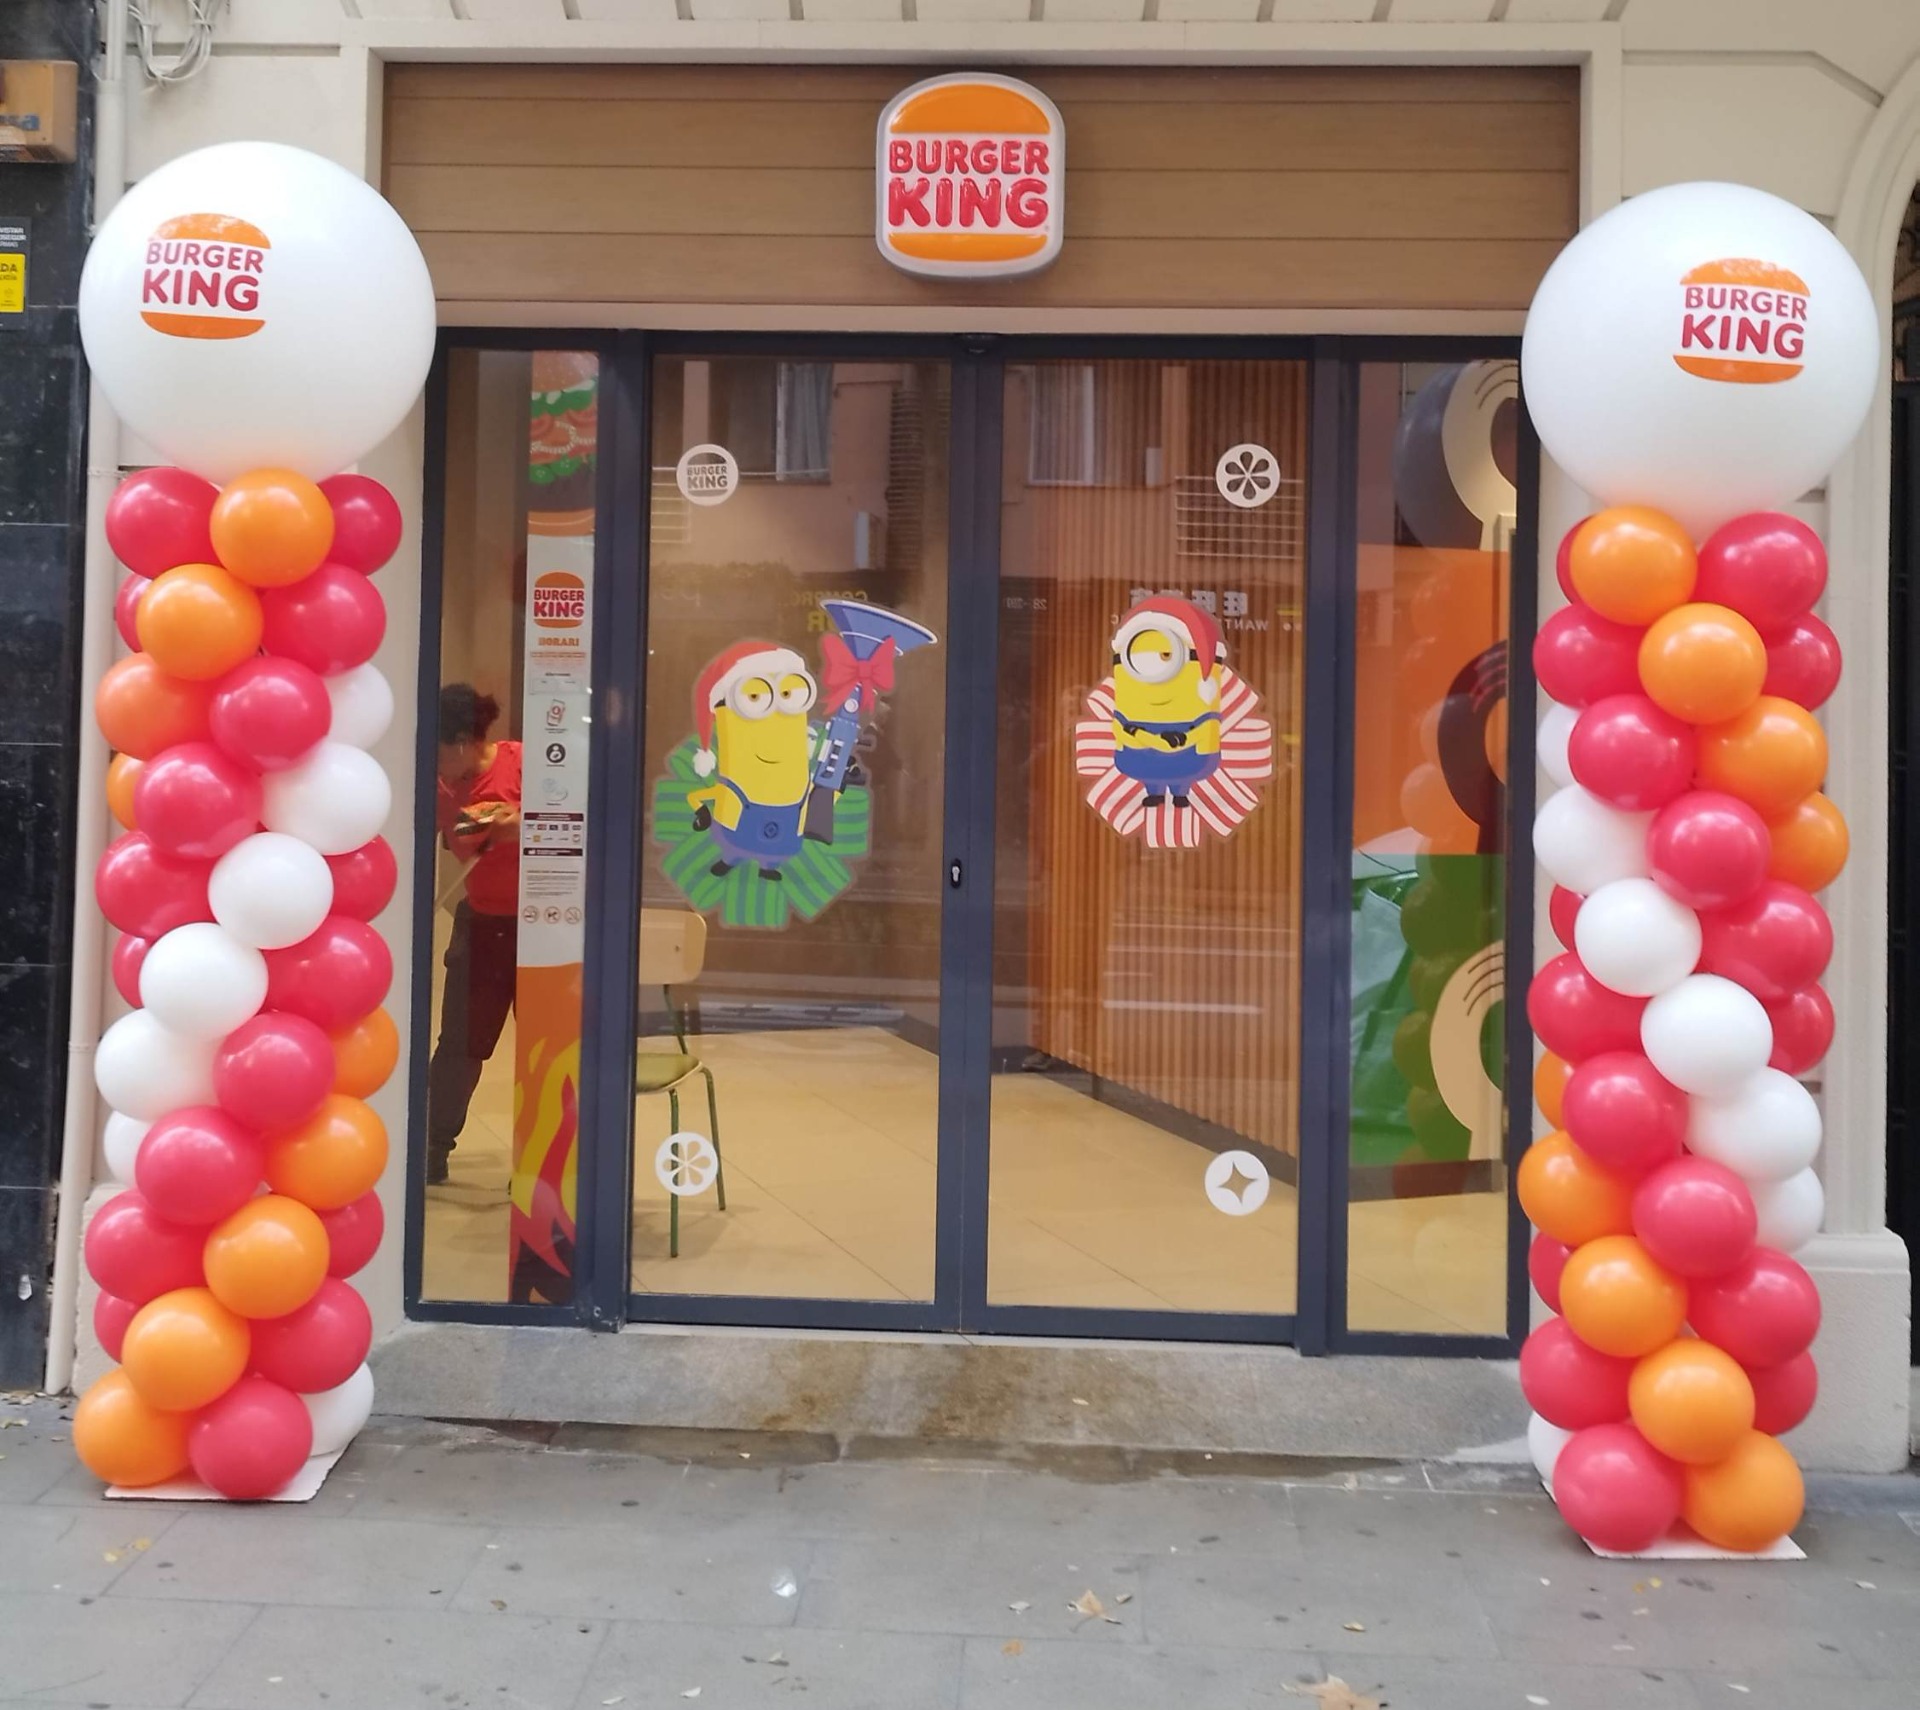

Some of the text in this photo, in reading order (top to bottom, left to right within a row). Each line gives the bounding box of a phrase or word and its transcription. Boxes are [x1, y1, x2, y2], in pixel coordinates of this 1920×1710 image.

[889, 140, 1050, 175] BURGER
[888, 177, 1049, 228] KING
[146, 242, 264, 273] BURGER
[142, 268, 259, 311] KING
[1685, 286, 1808, 321] BURGER
[1681, 313, 1805, 359] KING
[687, 465, 728, 476] BURGER
[687, 475, 728, 489] KING
[533, 589, 585, 601] BURGER
[533, 602, 585, 618] KING
